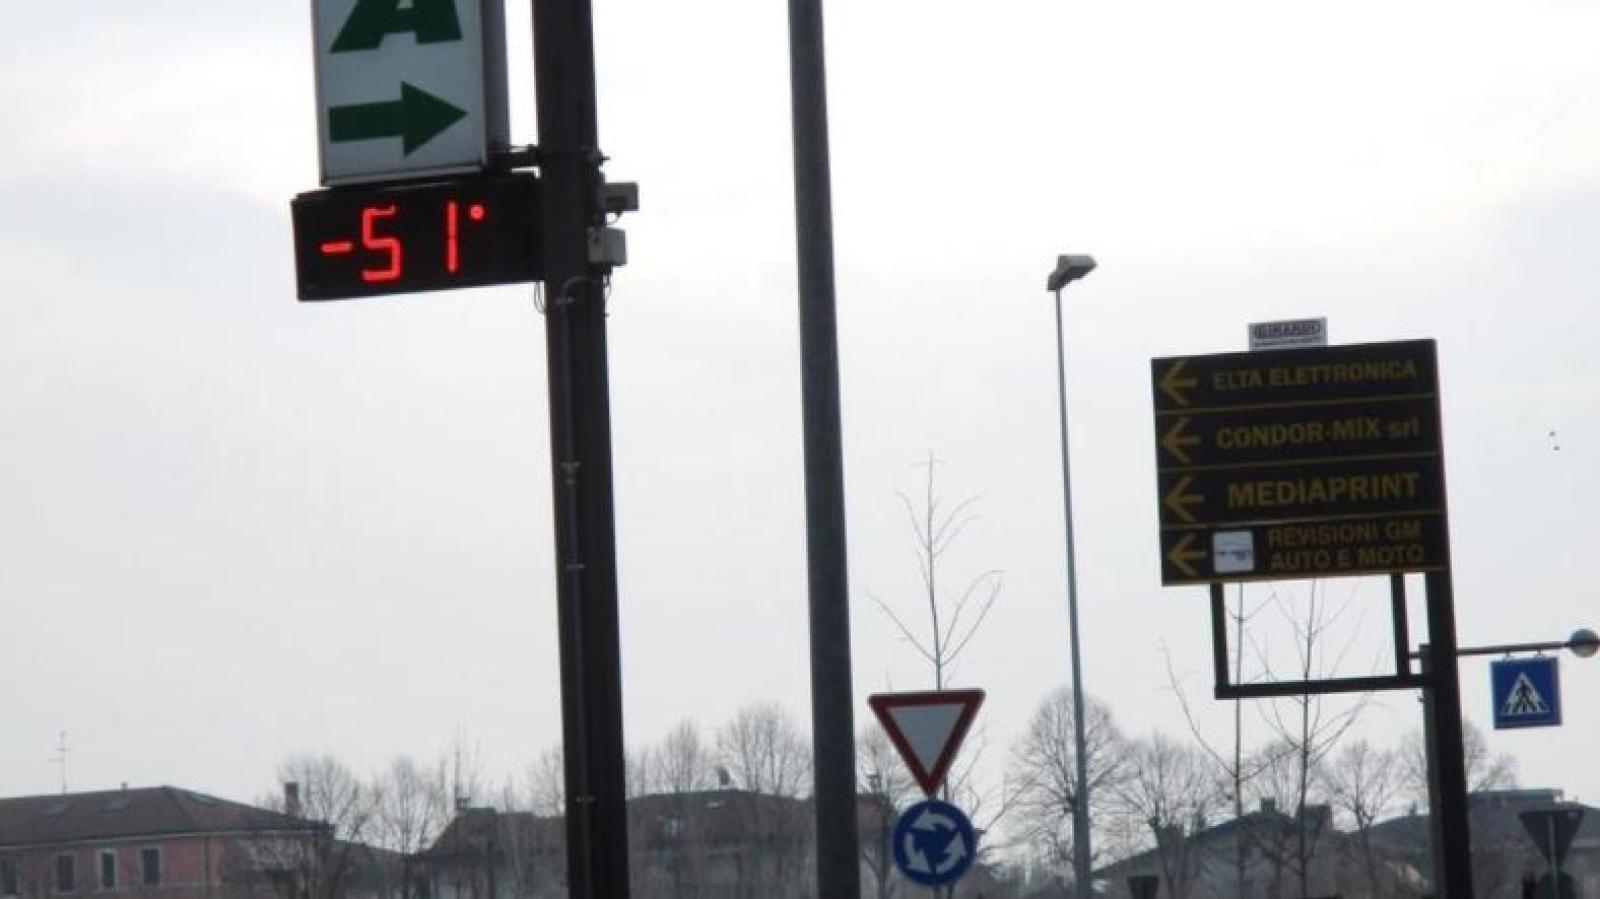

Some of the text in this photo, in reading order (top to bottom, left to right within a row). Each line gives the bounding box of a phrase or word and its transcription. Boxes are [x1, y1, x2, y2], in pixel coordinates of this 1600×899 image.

[1213, 359, 1417, 390] ELTA ELETTRONICA
[1389, 416, 1419, 439] srl
[1227, 472, 1420, 508] MEDIAPRINT
[1267, 519, 1422, 547] REVISIONI GM
[1269, 550, 1331, 571] AUTO
[1337, 548, 1350, 568] E
[1358, 544, 1424, 568] MOTO
